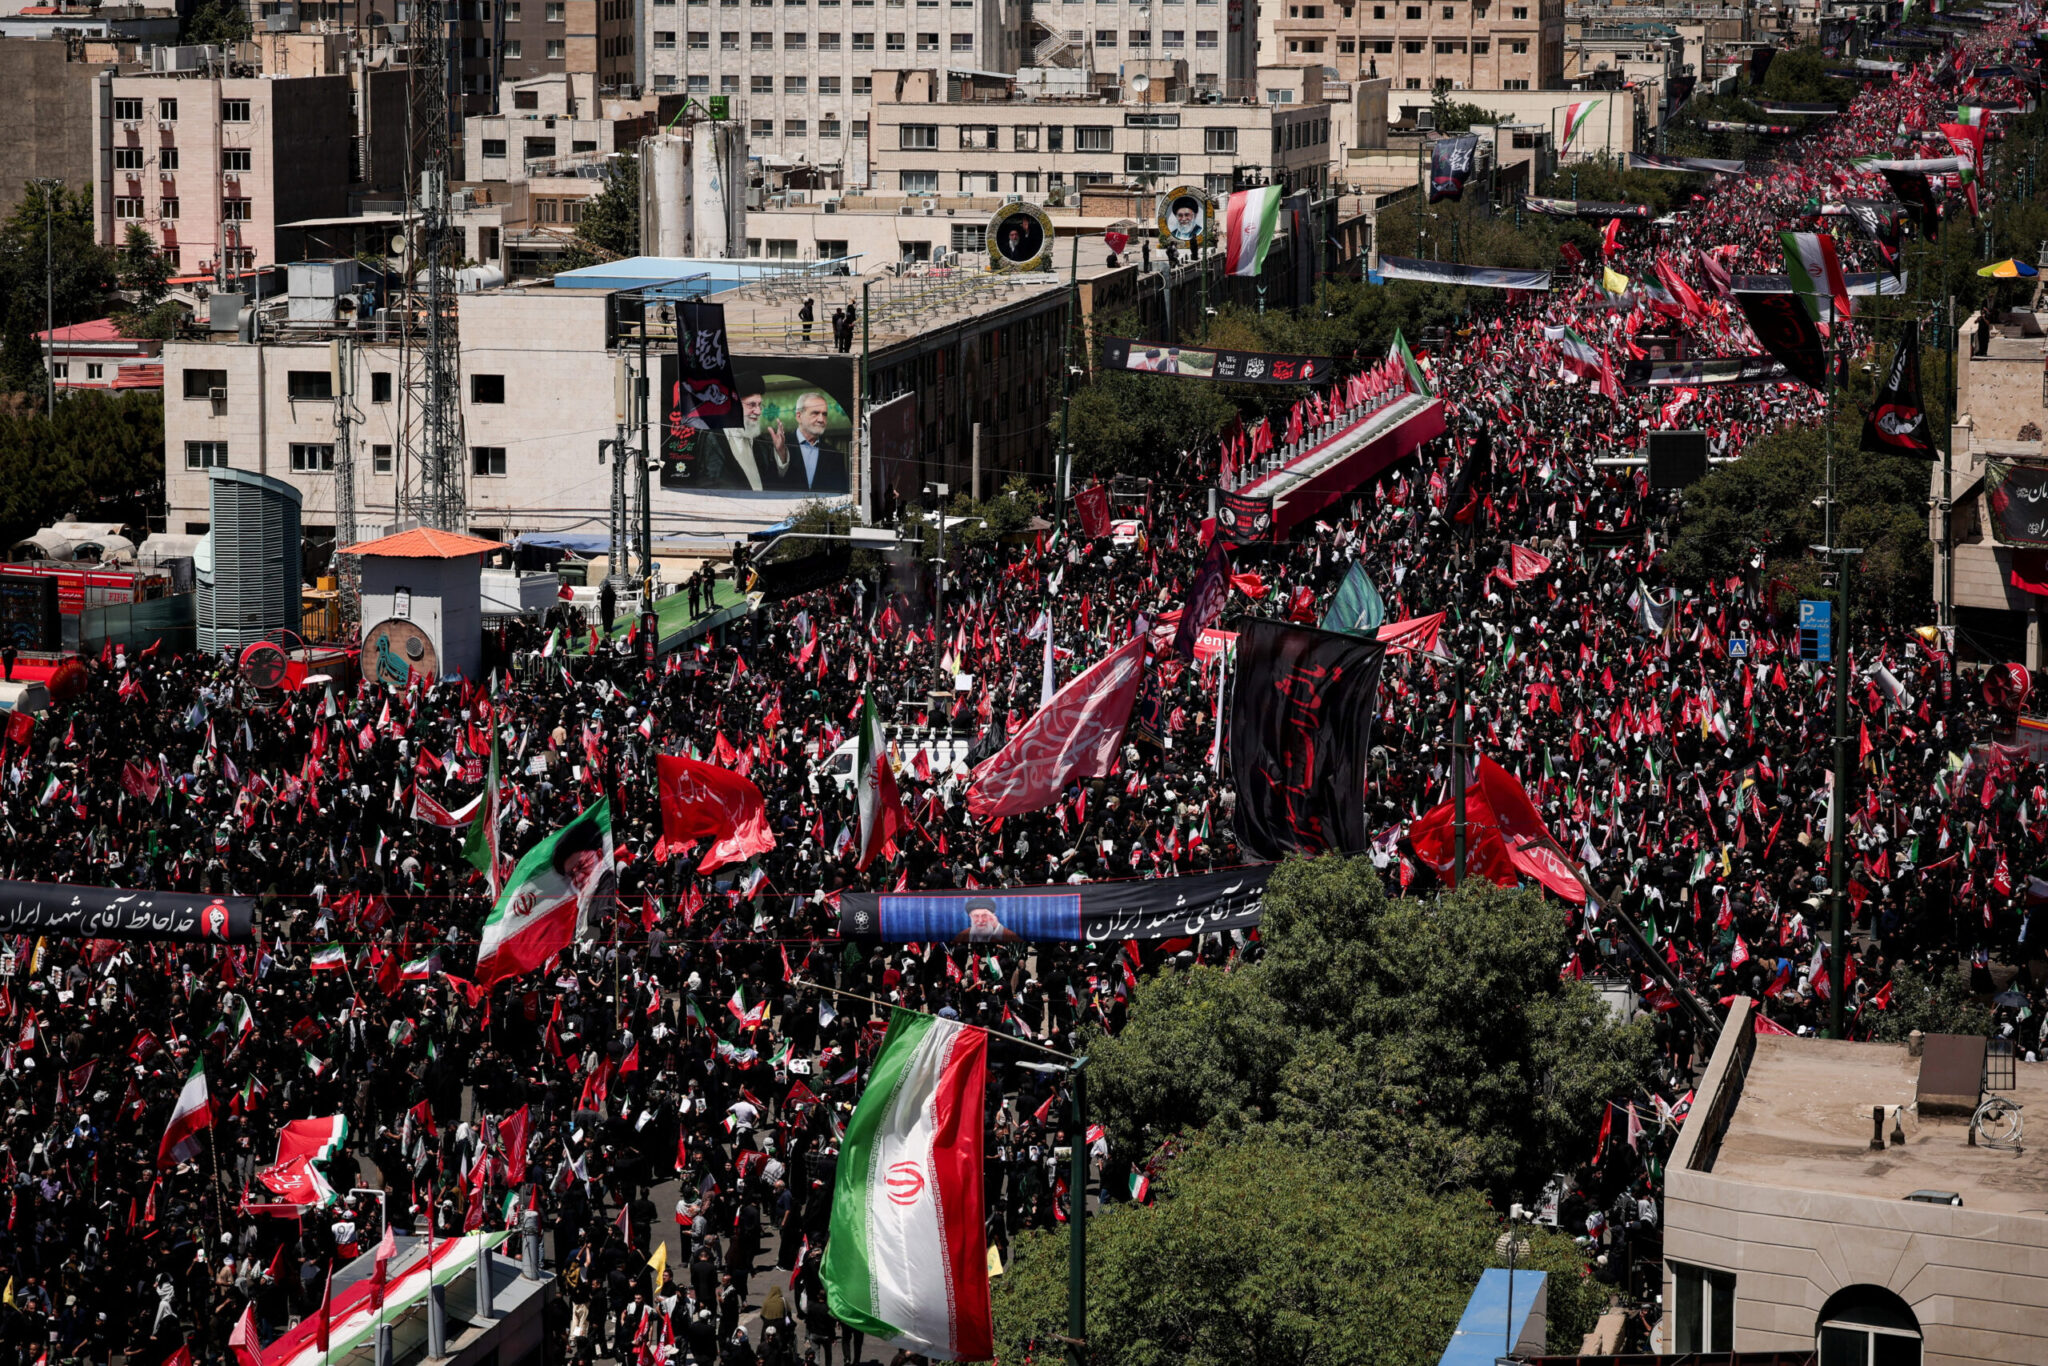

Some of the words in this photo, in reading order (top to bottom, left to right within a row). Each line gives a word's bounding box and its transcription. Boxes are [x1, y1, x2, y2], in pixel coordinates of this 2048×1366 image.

[1218, 361, 1236, 370] Must
[1219, 368, 1234, 376] Rise
[1226, 355, 1237, 363] We
[108, 591, 128, 603] FIRE
[1800, 604, 1815, 622] P
[45, 895, 82, 936] شهید
[80, 893, 137, 938] آقای
[1147, 892, 1188, 941] شهید
[1184, 879, 1243, 934] آقای
[1086, 904, 1142, 943] ایران
